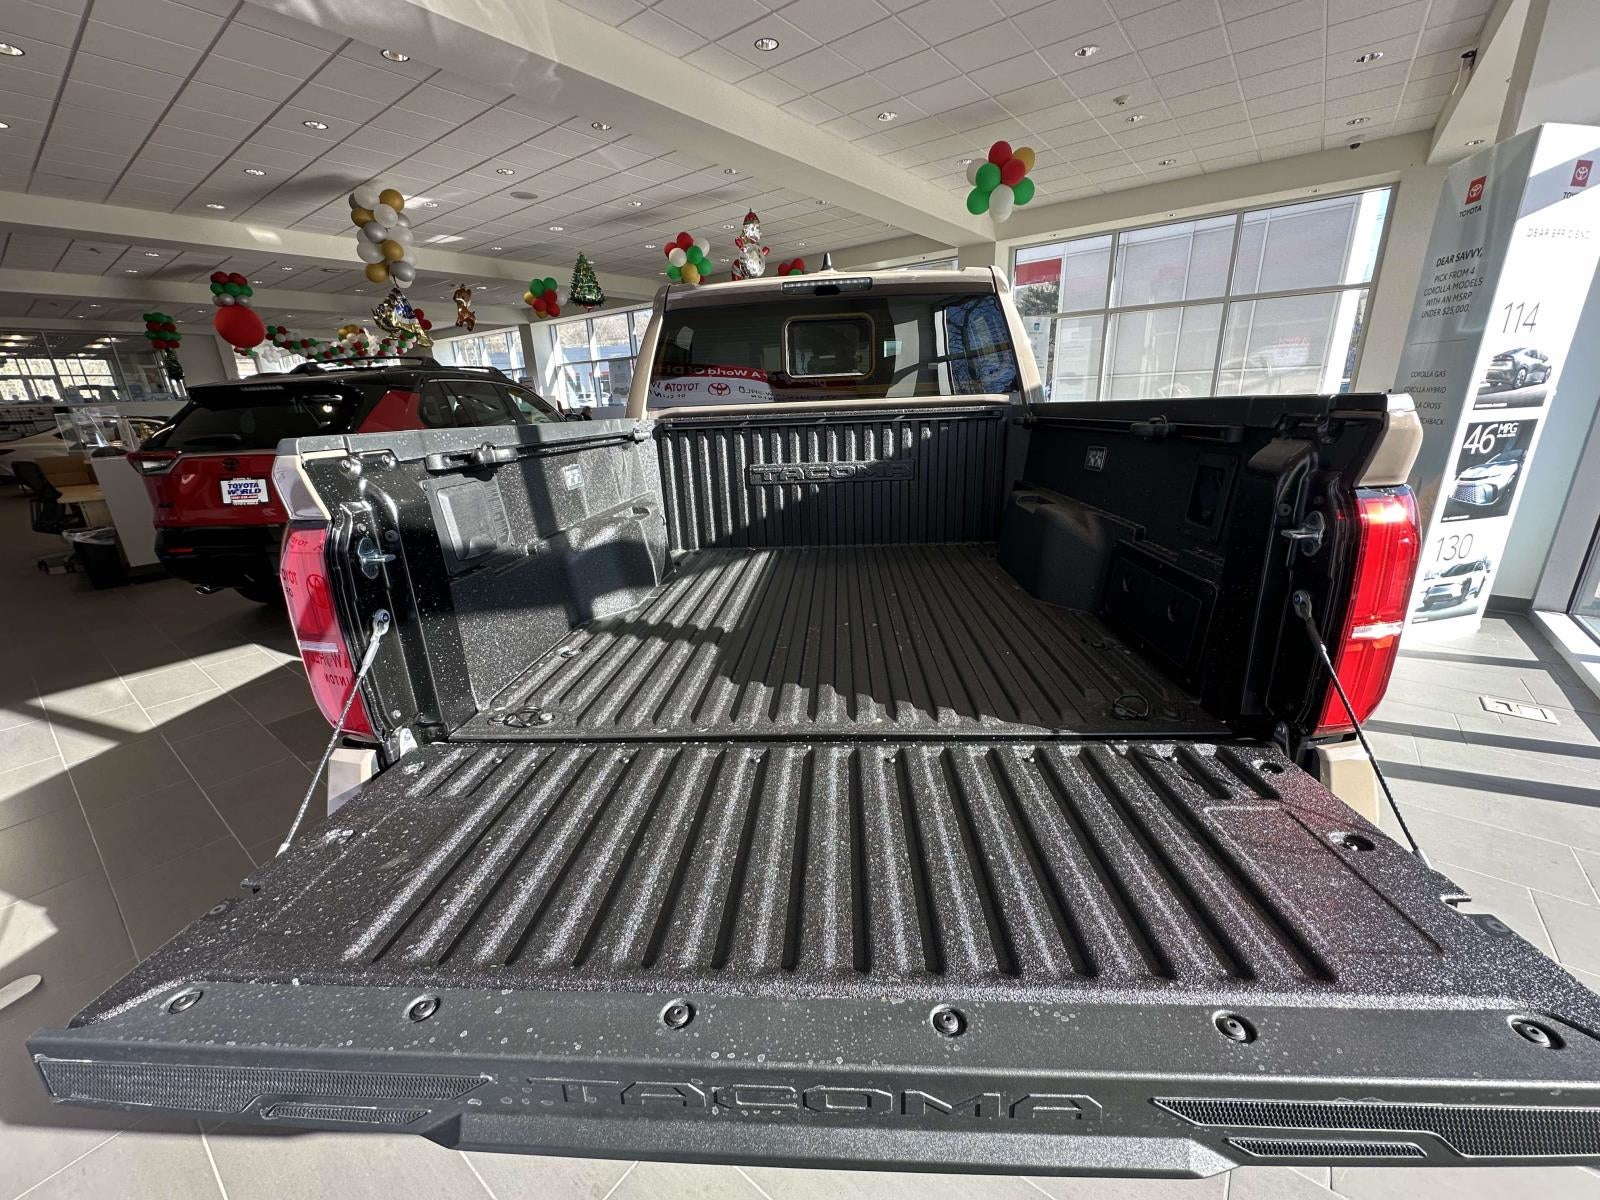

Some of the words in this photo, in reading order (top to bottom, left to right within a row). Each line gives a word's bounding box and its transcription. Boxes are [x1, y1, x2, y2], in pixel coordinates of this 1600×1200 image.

[1459, 204, 1482, 218] TOYOTA
[1436, 253, 1456, 267] DEAR
[1455, 246, 1483, 262] SAVVY,
[1434, 272, 1449, 283] PICK
[1449, 268, 1469, 280] FROM
[1423, 284, 1451, 297] COROLLA
[1453, 277, 1484, 290] MODELS
[1425, 297, 1440, 307] WITH
[1441, 294, 1452, 303] AN
[1453, 291, 1473, 302] MSRP
[1421, 308, 1441, 318] UNDER
[1502, 301, 1541, 334] 114
[1410, 370, 1434, 378] COROLLA
[1423, 401, 1441, 410] CROSS
[1463, 423, 1499, 455] 46
[1498, 422, 1520, 434] MPG
[752, 462, 911, 482] TACOMA
[228, 482, 259, 490] TOYOTA
[1435, 533, 1474, 563] 130
[526, 1076, 1105, 1121] TACOMA
